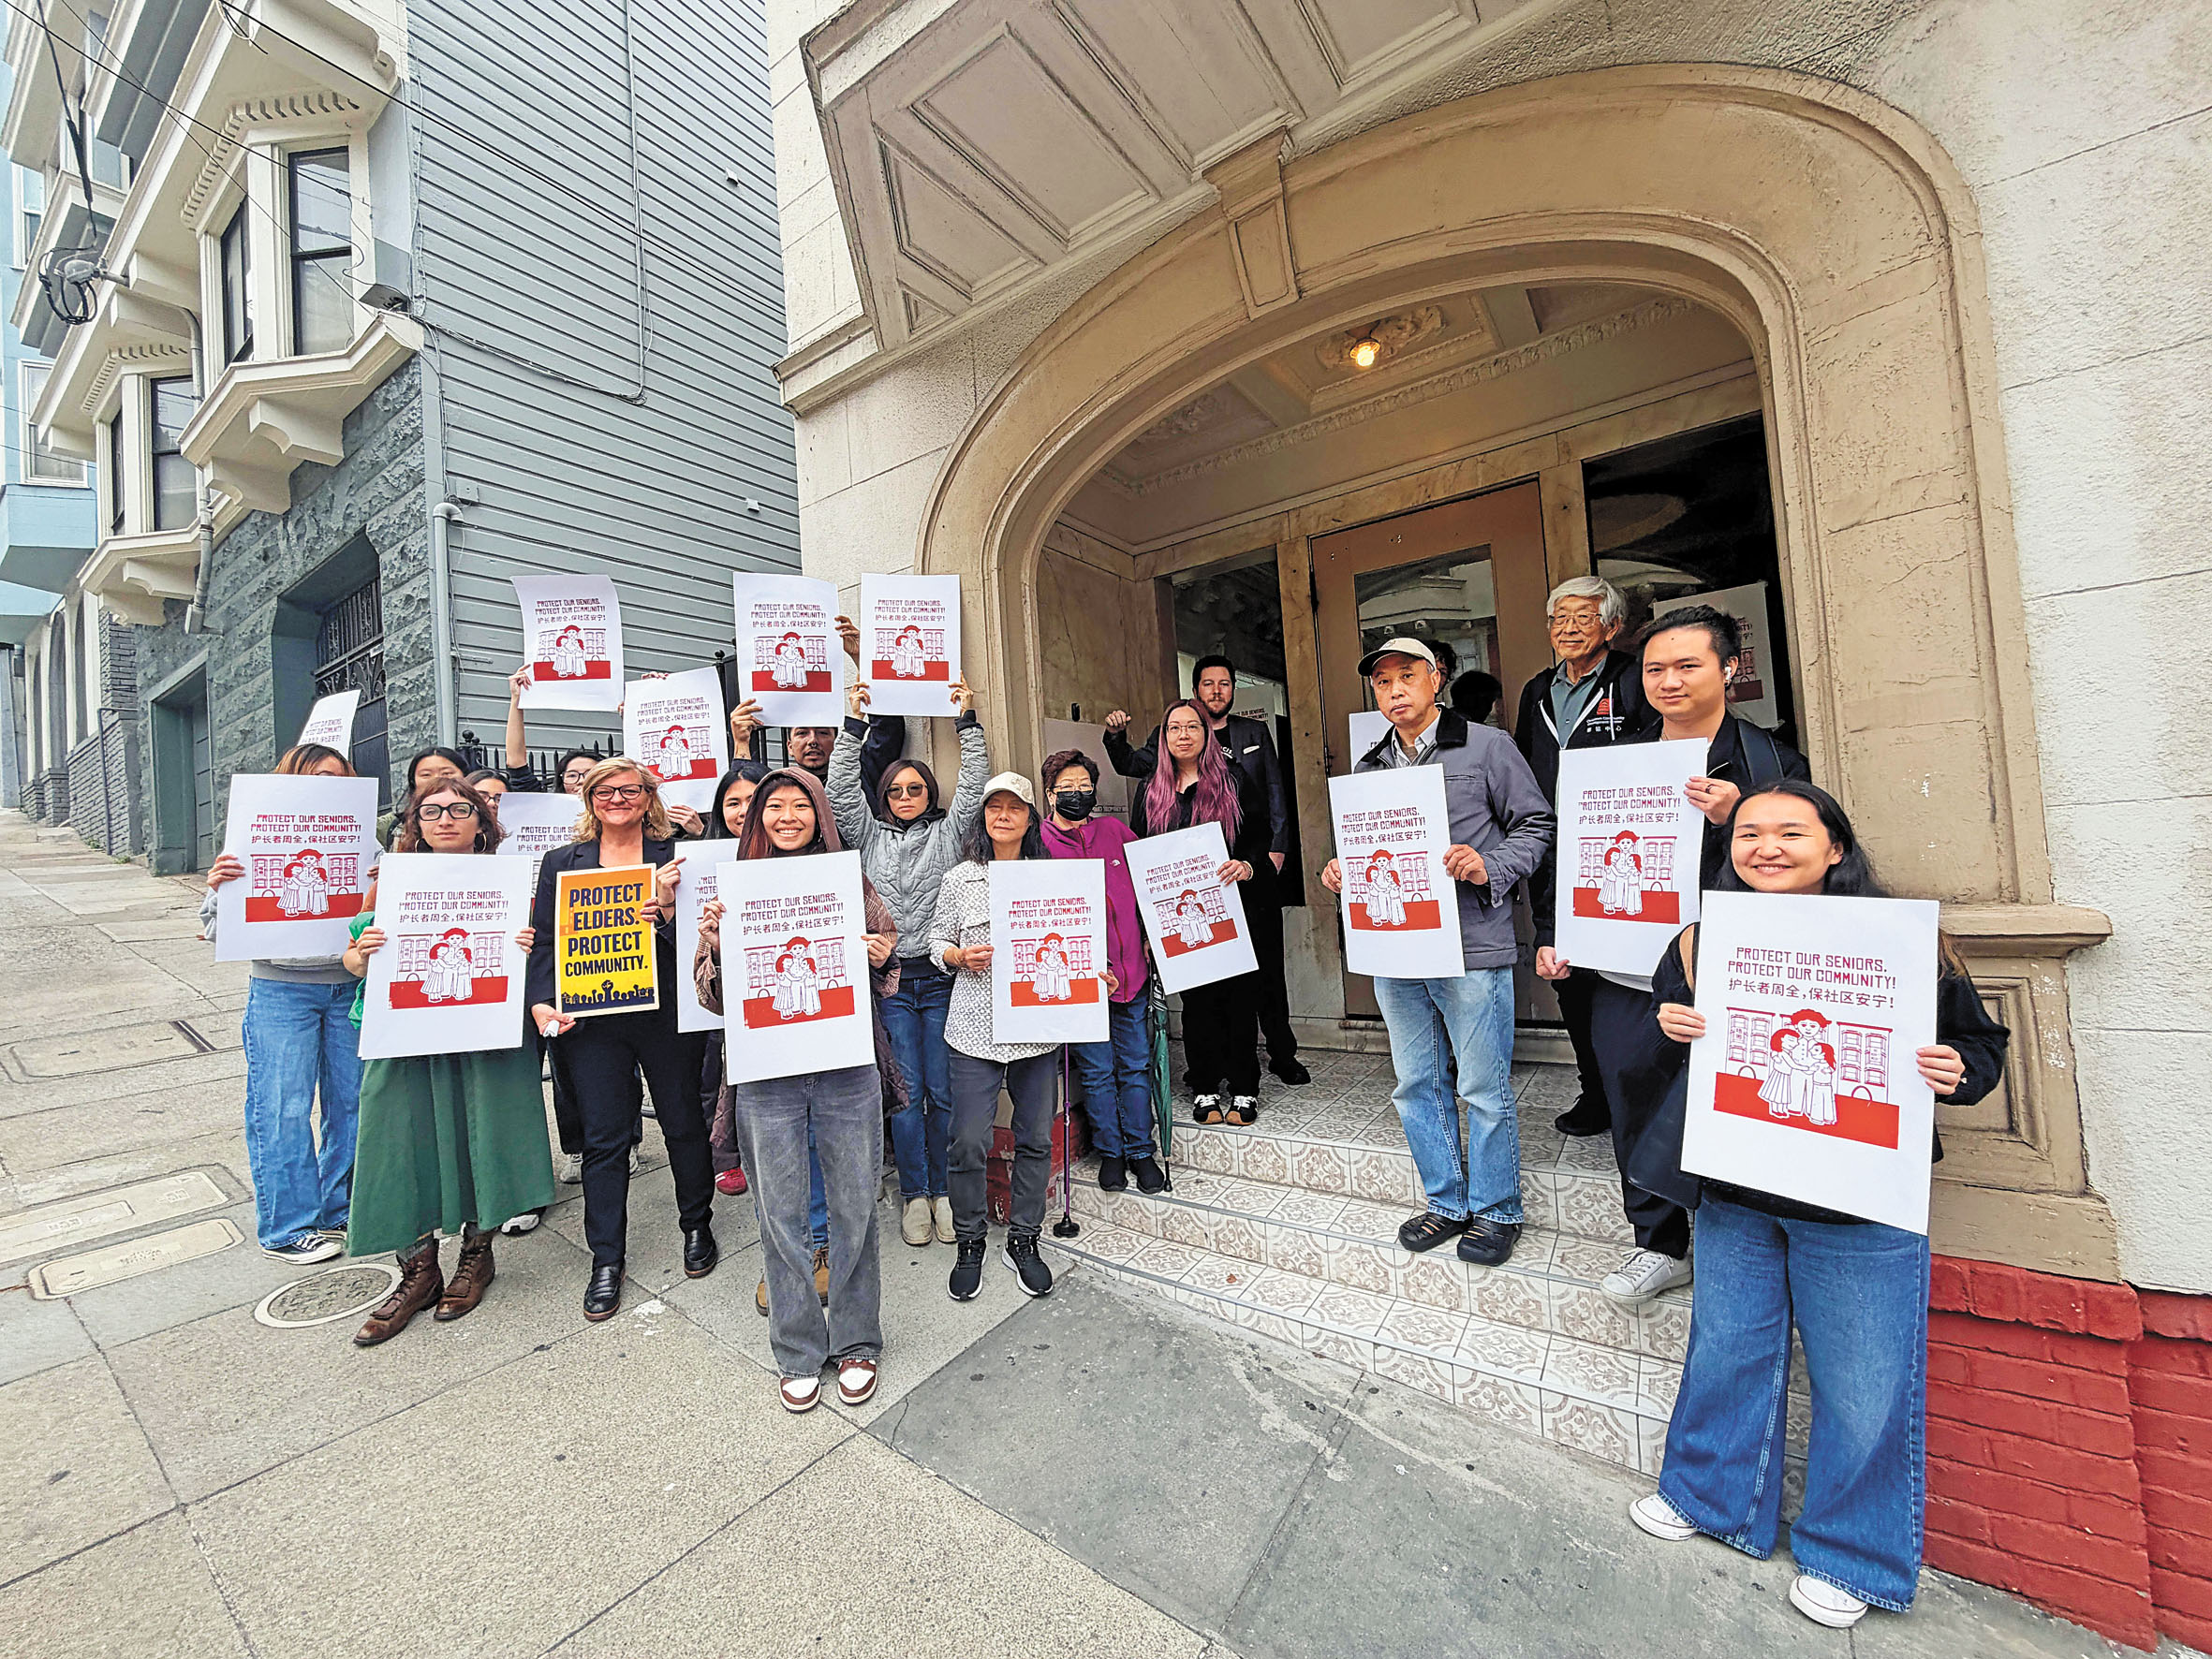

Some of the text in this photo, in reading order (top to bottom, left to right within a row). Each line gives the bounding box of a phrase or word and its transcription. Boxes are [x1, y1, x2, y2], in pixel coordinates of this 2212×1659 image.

[641, 700, 665, 709] PROTECT
[1583, 786, 1674, 800] PROTECT OUR SENIORS.
[1614, 800, 1628, 809] OUR
[1630, 798, 1680, 809] COMMUNITY!
[1343, 807, 1420, 823] PROTECT OUR SENIORS.
[313, 824, 361, 832] COMMUNITY!
[1365, 822, 1379, 831] OUR
[1380, 817, 1425, 830] COMMUNITY!
[1147, 864, 1172, 876] PROTECT
[1173, 860, 1185, 870] OUR
[1145, 874, 1170, 885] PROTECT
[1172, 870, 1183, 878] OUR
[448, 891, 464, 900] OUR
[569, 883, 643, 907] PROTECT
[695, 886, 717, 894] PROTE
[399, 901, 509, 911] PROTECT OUR COMMUNITY!
[745, 893, 838, 910] PROTECT OUR SENIORS.
[1012, 897, 1086, 908] PROTECT OUR SENIORS.
[574, 907, 640, 932] ELDERS.
[741, 903, 843, 922] PROTECT OUR COMMUNITY!
[1009, 906, 1091, 918] PROTECT OUR COMMUNITY!
[568, 932, 642, 957] PROTECT
[566, 955, 648, 977] COMMUNITY.
[1736, 947, 1887, 973] PROTECT OUR SENIORS.
[1728, 962, 1896, 990] PROTECT OUR COMMUNITY!
